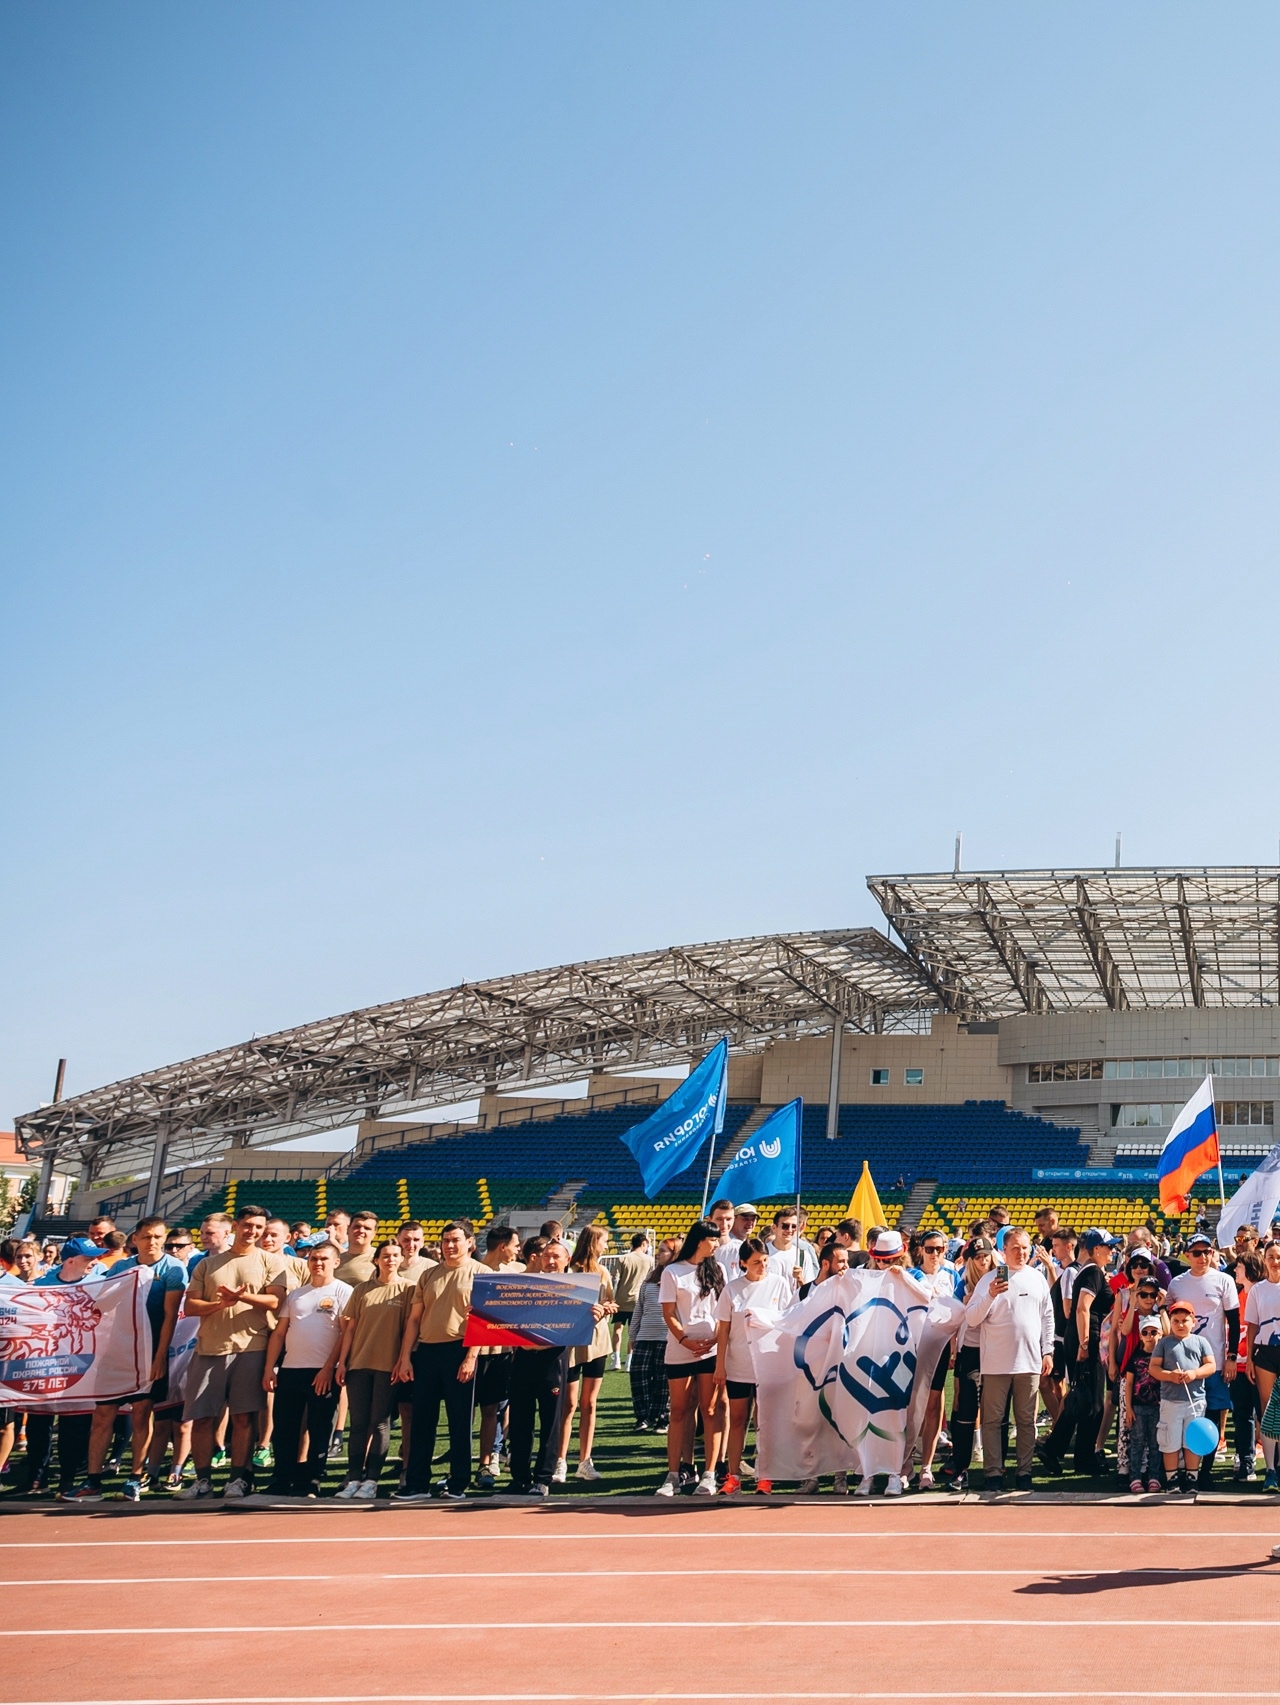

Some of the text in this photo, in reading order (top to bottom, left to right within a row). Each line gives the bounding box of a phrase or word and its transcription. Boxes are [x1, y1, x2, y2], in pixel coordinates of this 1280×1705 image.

[25, 1356, 70, 1369] ПОЖАРНОЙ
[12, 1366, 78, 1379] ОХРАНЕ РОССИИ
[22, 1377, 69, 1391] 375 ЛЕТ
